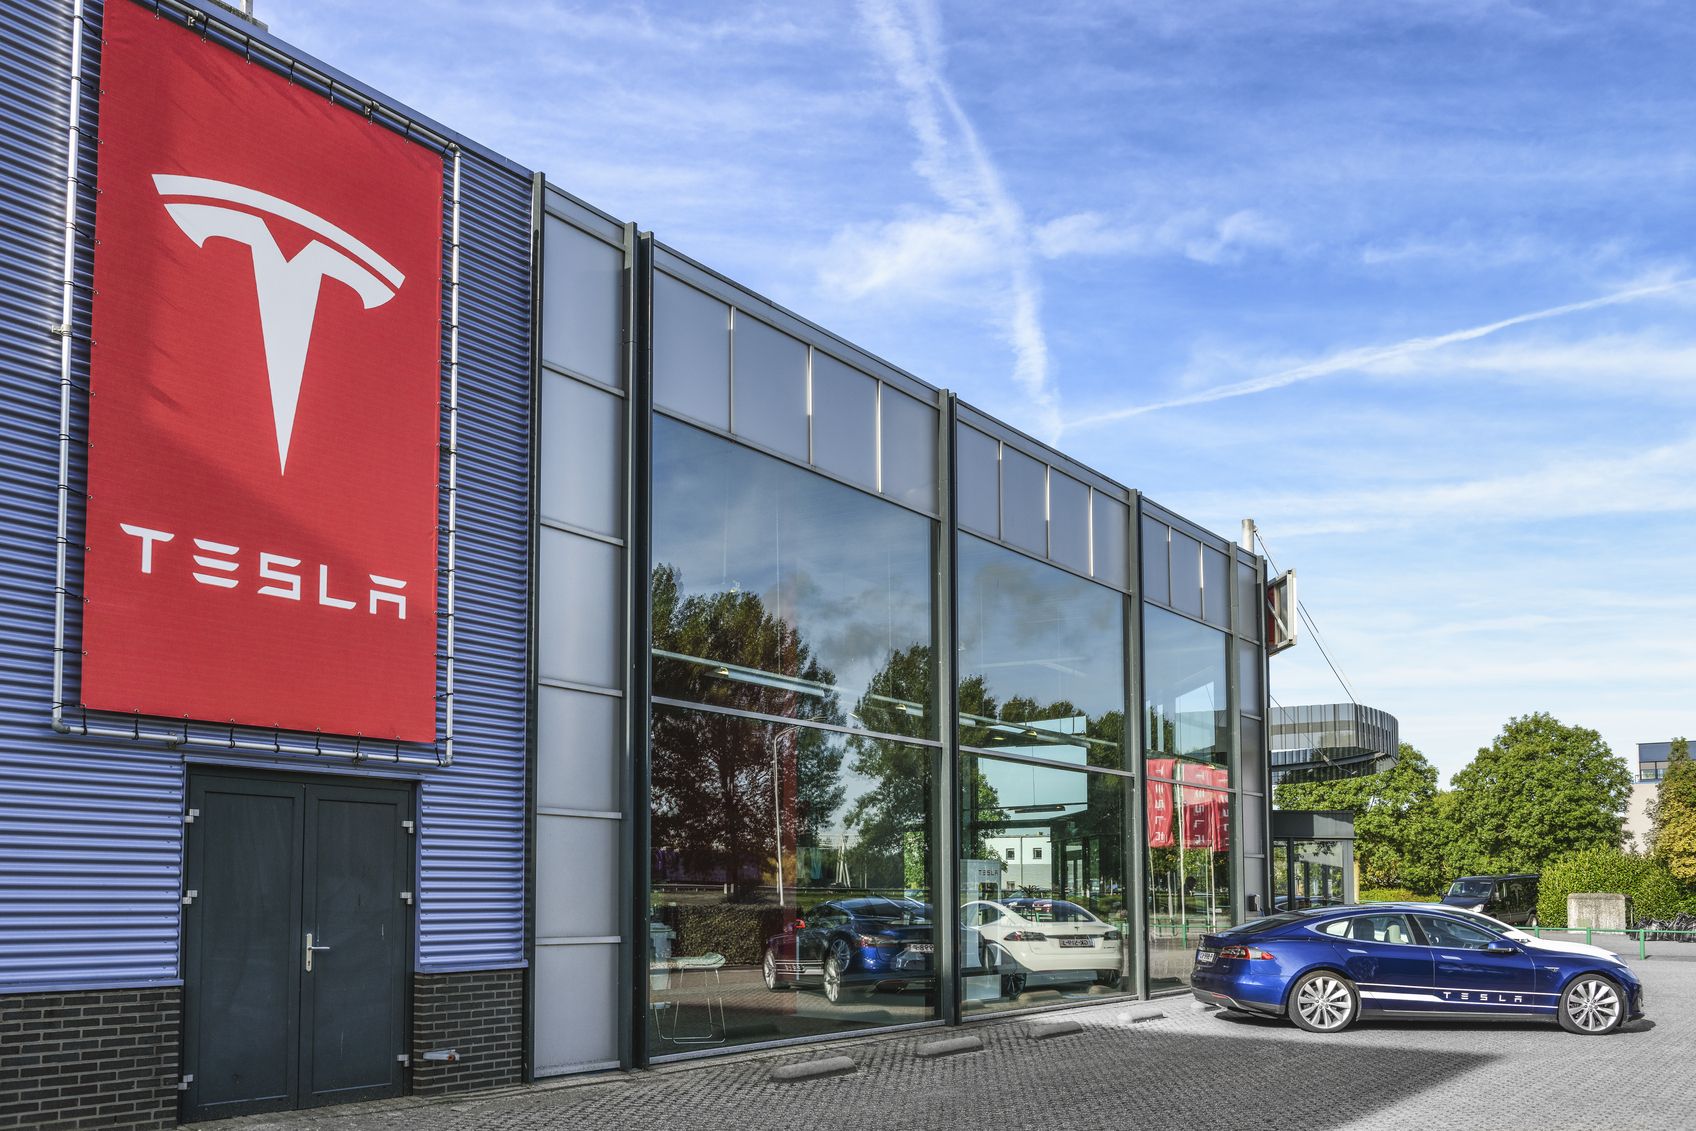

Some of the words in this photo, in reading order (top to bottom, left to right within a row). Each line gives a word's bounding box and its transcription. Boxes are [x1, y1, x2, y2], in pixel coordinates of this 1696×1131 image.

[119, 523, 407, 620] TESLA
[1154, 766, 1168, 842] TESLA
[1193, 771, 1205, 845] TESLA
[1442, 991, 1523, 1003] TESLA
